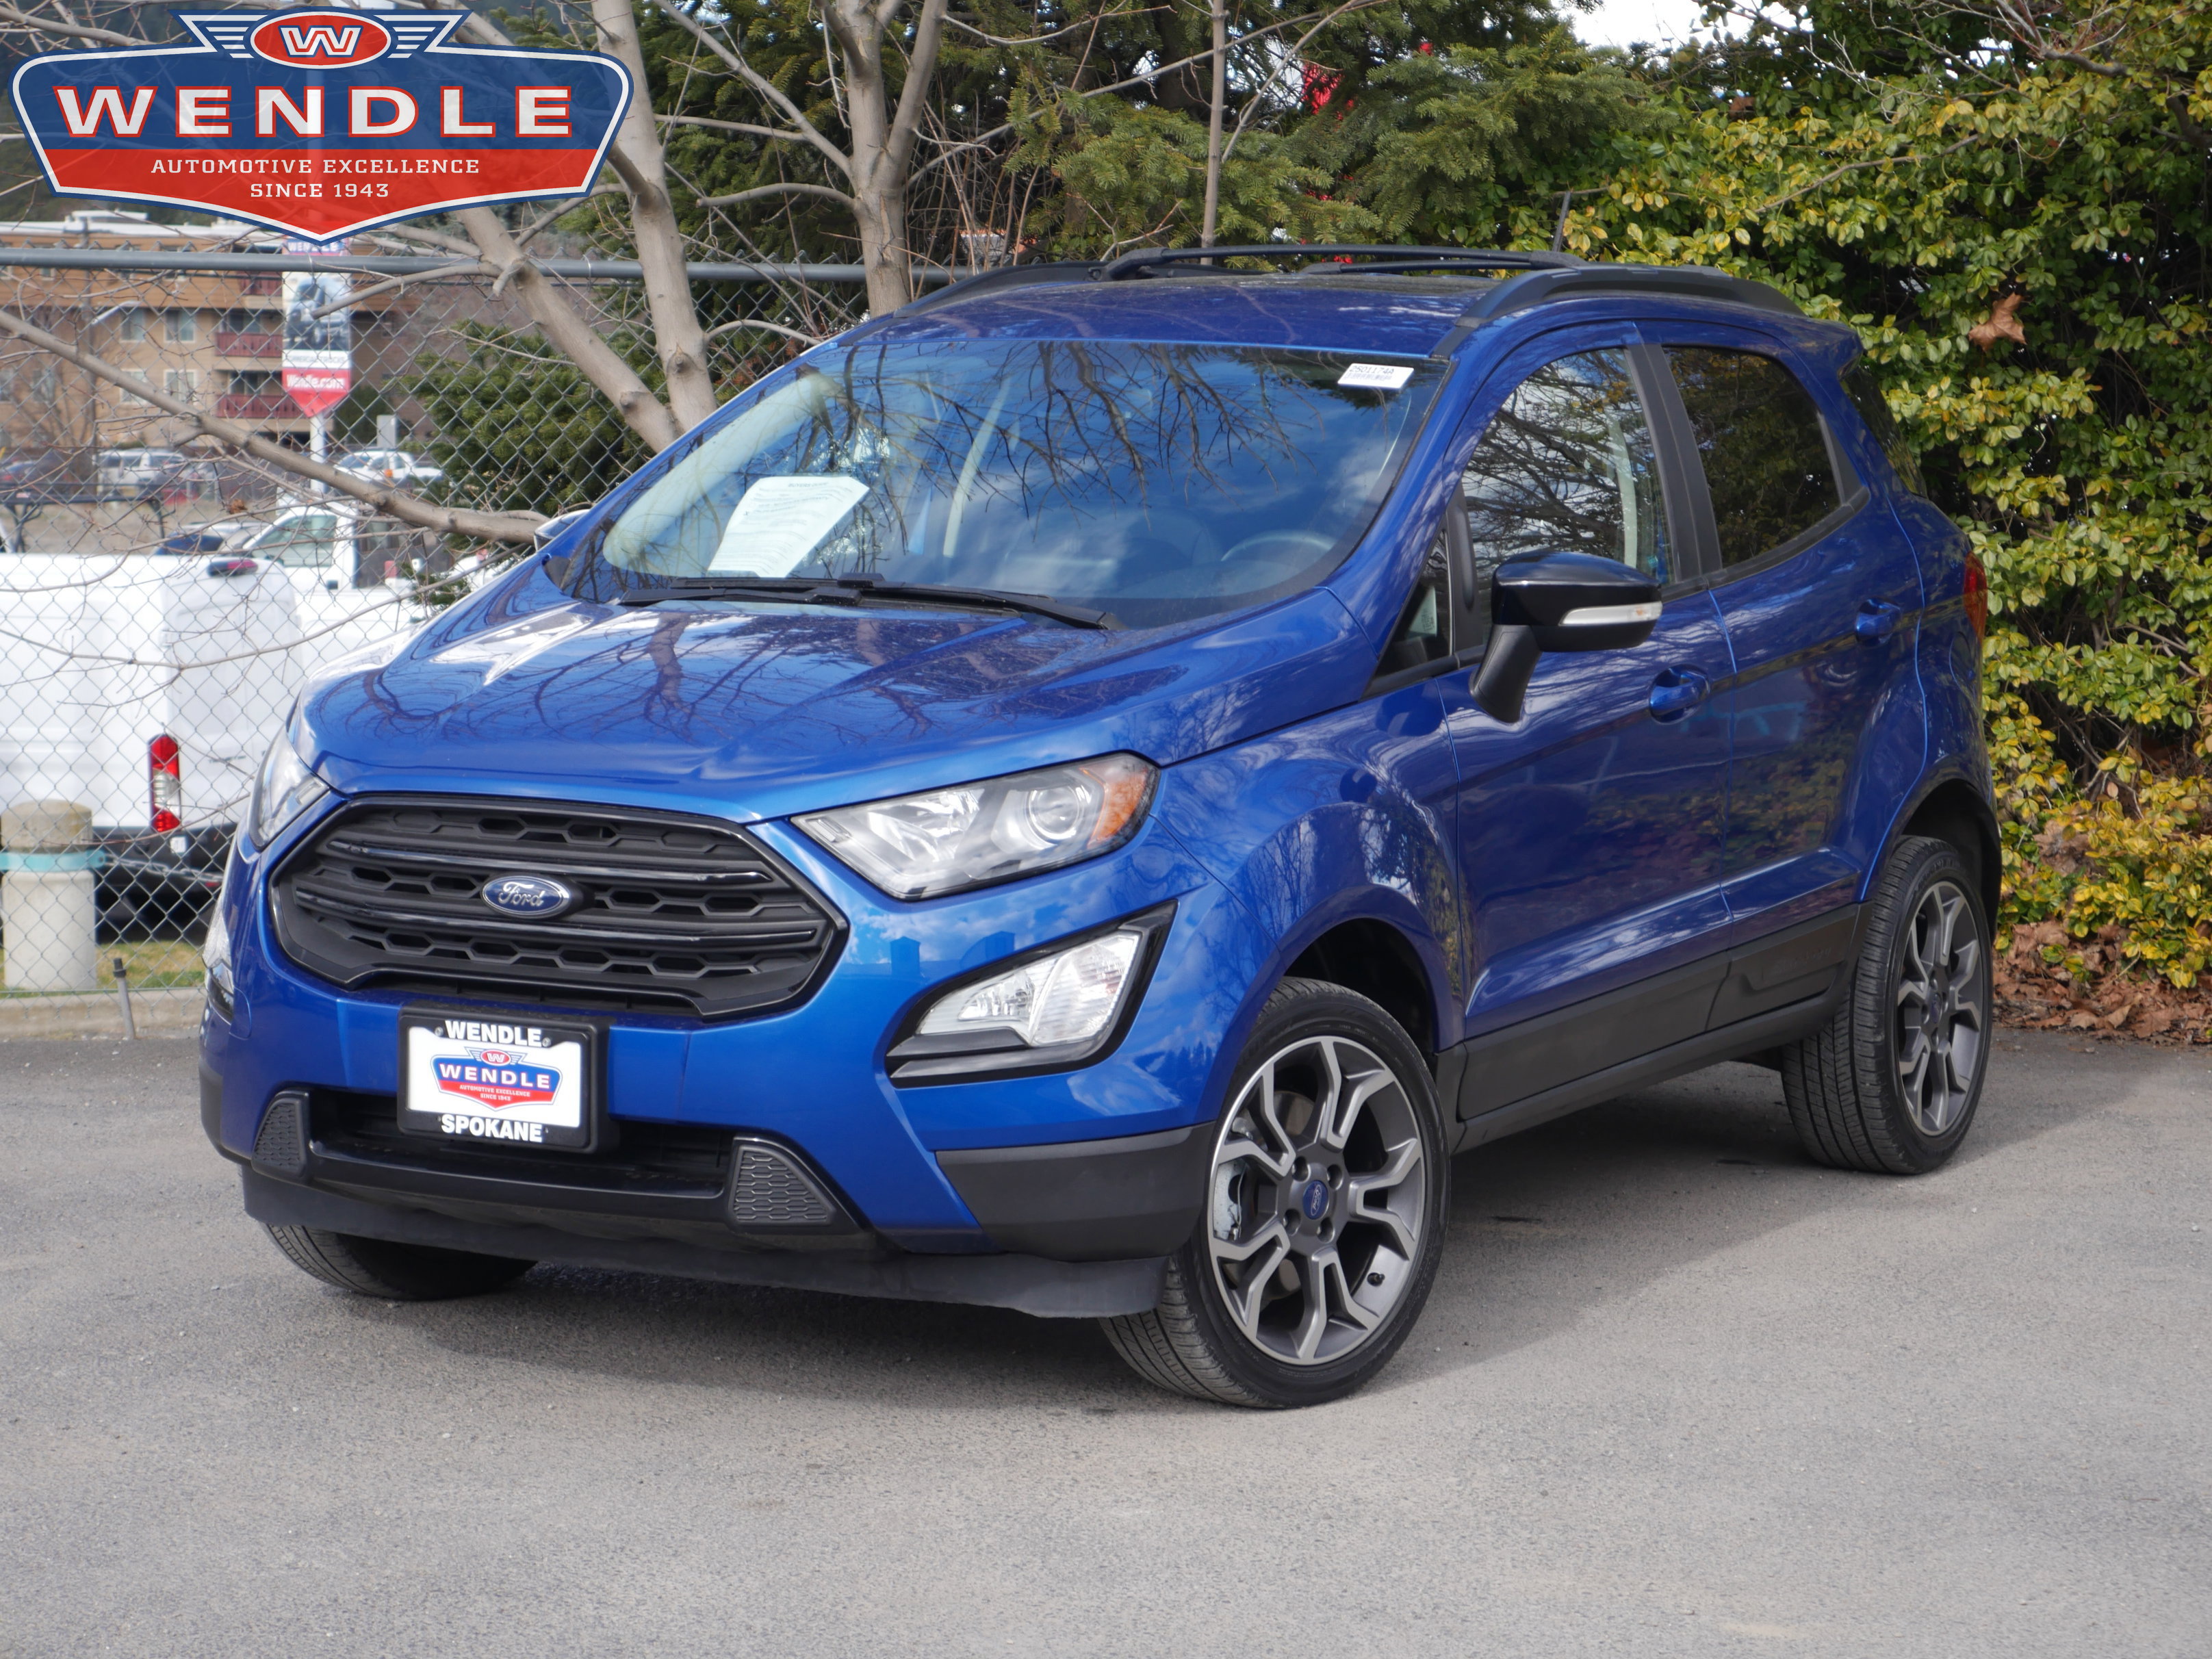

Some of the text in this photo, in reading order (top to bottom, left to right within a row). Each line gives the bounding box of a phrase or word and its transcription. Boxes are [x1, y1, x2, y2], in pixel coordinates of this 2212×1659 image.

[498, 882, 545, 907] Ford
[445, 1019, 543, 1048] WENDLE
[439, 1063, 550, 1090] WENDLE
[459, 1084, 530, 1097] AUTOMOTIVE EXCELLENCE
[441, 1114, 543, 1143] SPOKANE
